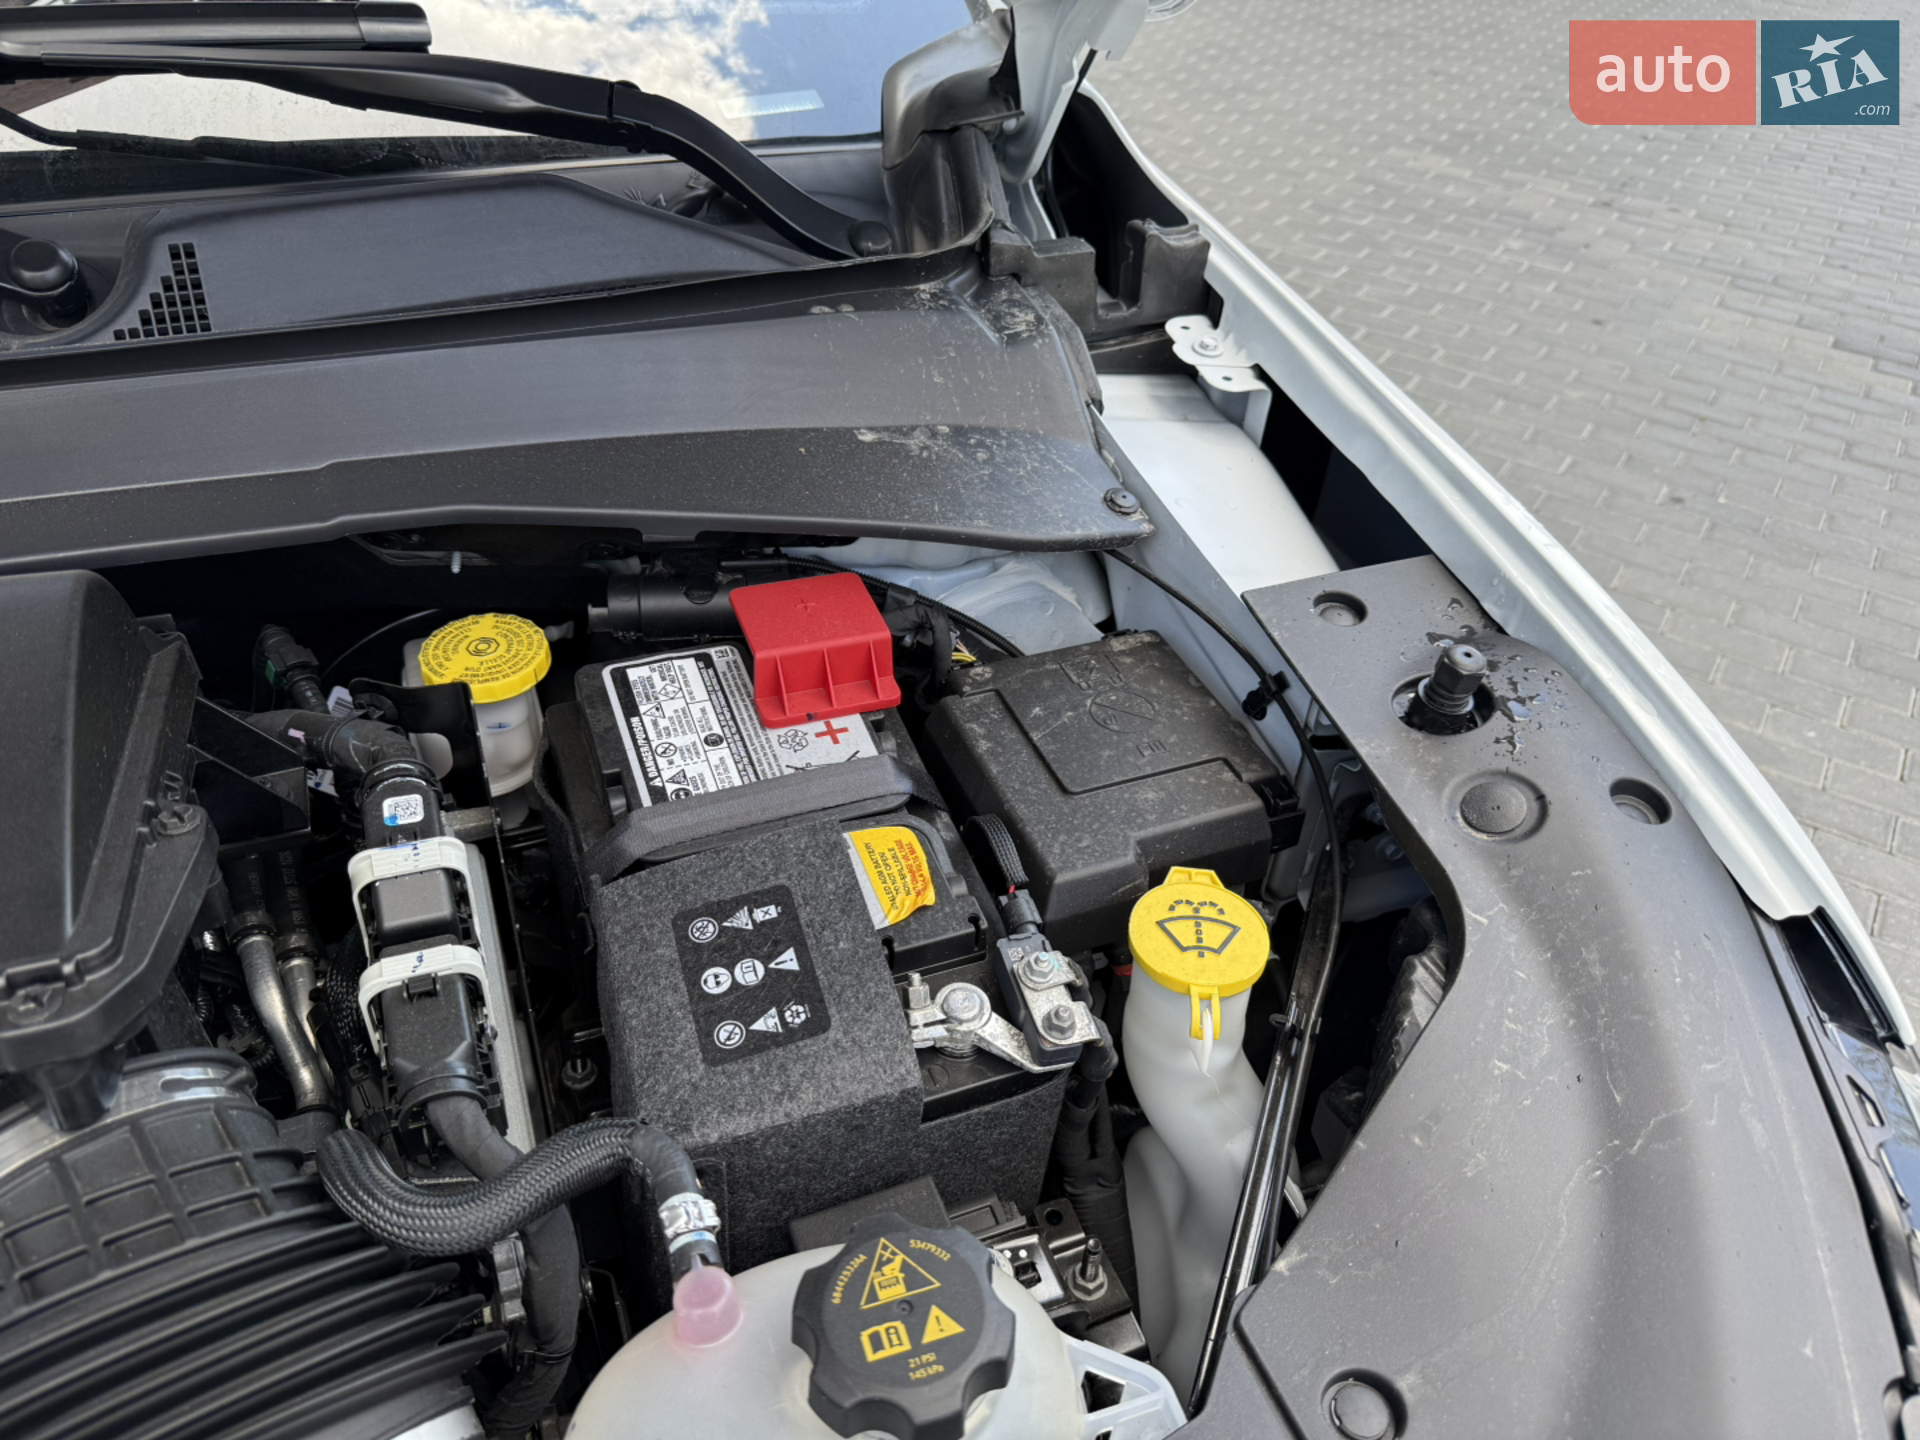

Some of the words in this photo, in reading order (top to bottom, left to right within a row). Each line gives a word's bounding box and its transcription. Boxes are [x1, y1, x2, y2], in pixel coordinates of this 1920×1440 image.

[629, 715, 659, 778] DANGER/POISON
[863, 841, 881, 869] BATTERY
[876, 869, 888, 885] AGM
[886, 871, 897, 885] NOT
